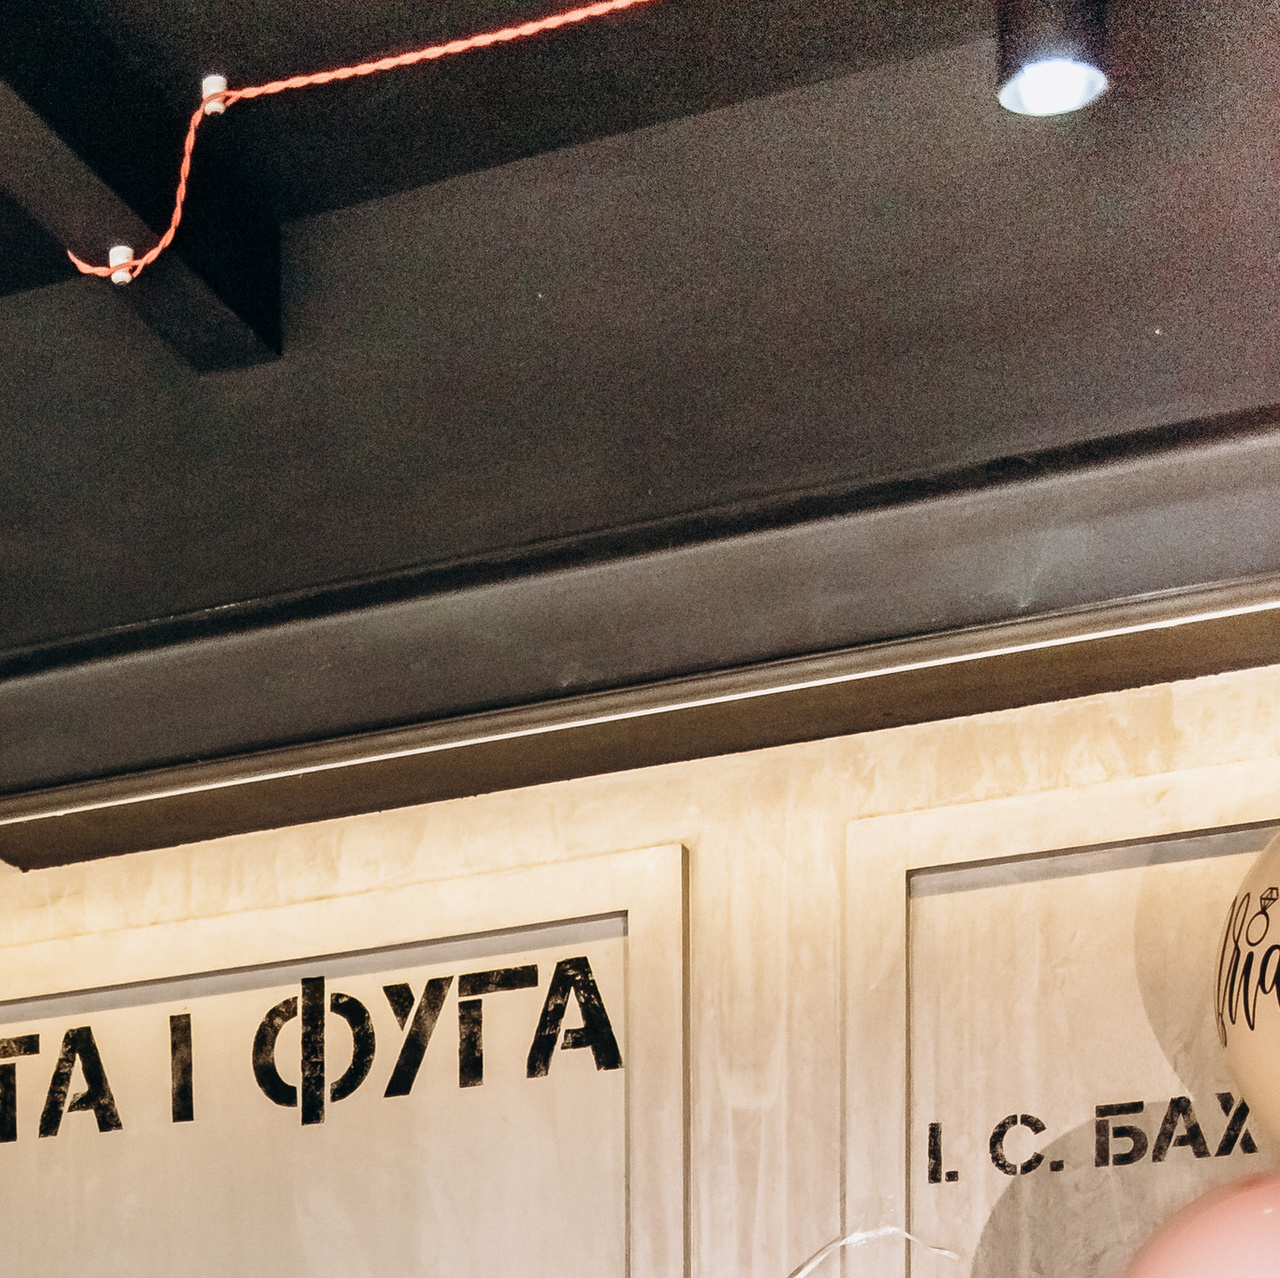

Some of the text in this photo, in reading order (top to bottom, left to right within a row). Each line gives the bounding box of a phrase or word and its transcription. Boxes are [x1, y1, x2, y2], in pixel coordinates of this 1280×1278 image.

[169, 1013, 195, 1123] І
[251, 956, 624, 1126] ФУГА
[1094, 1092, 1259, 1168] БАХ
